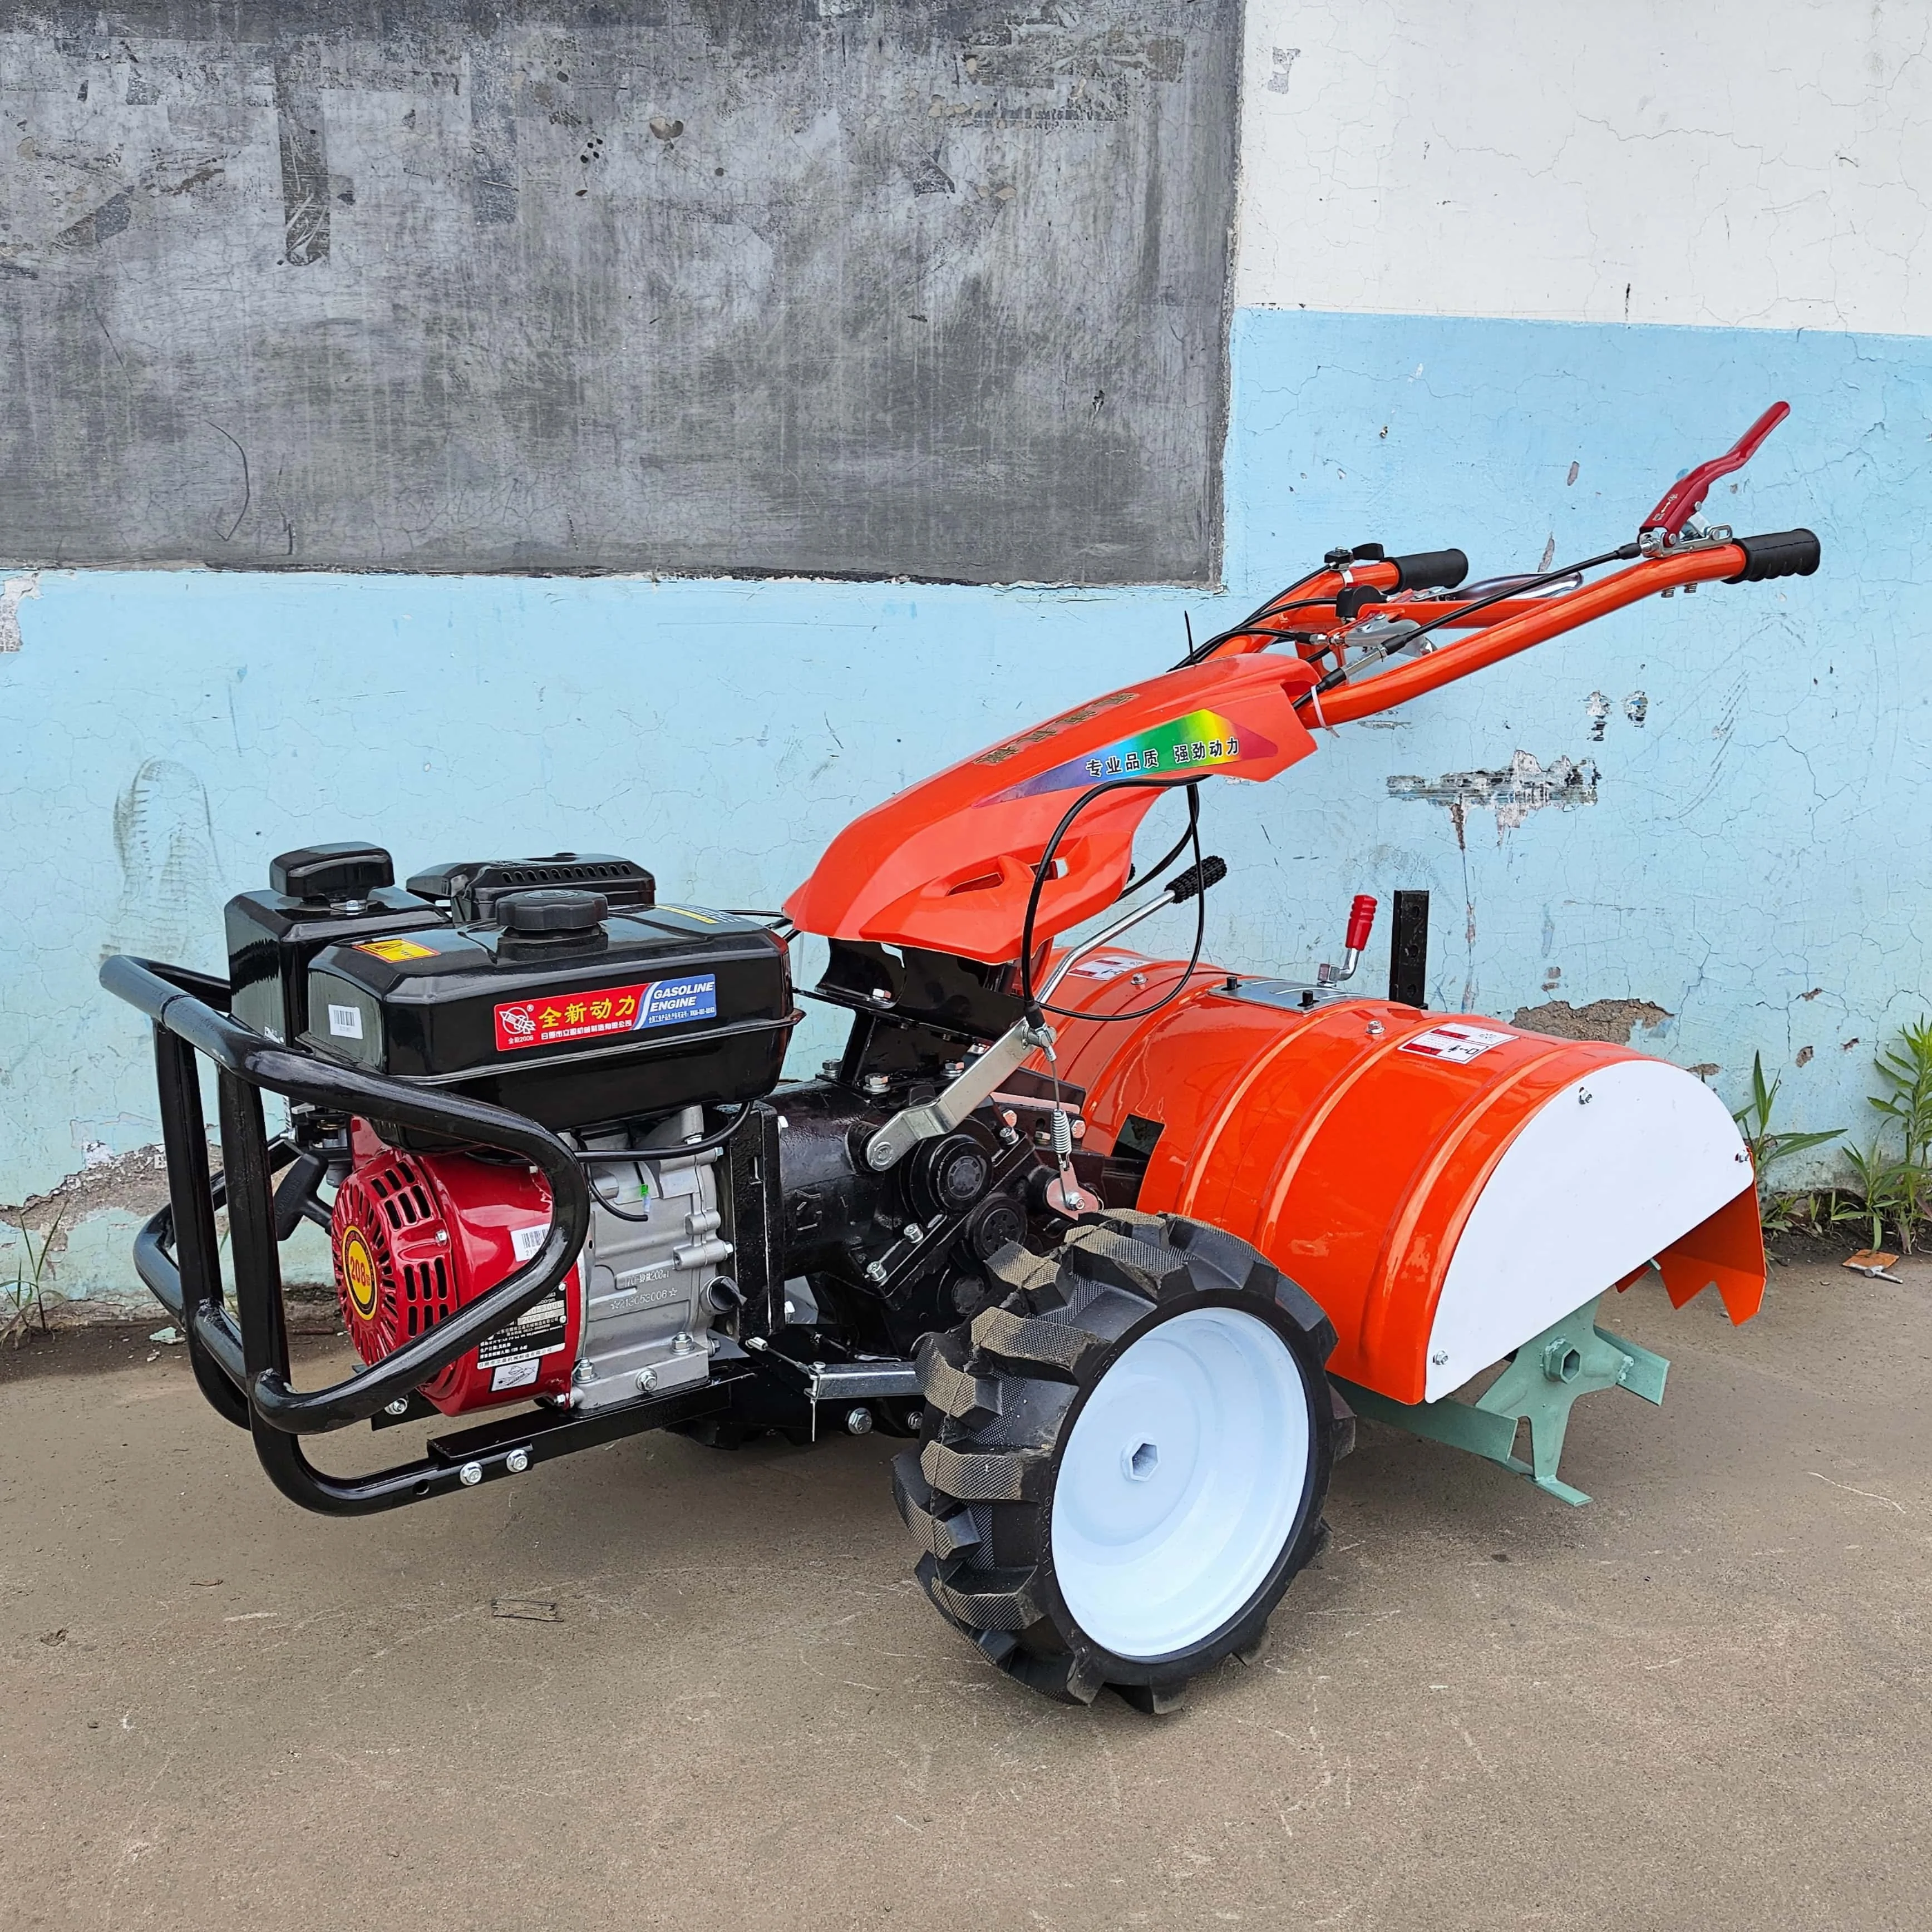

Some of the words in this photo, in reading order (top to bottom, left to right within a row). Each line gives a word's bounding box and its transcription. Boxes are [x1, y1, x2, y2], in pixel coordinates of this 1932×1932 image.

[1087, 749, 1159, 777] 专业品质
[1173, 736, 1239, 763] 强劲动力
[654, 981, 714, 999] GASOLINE
[539, 995, 636, 1028] 全新动力
[650, 996, 697, 1012] ENGINE
